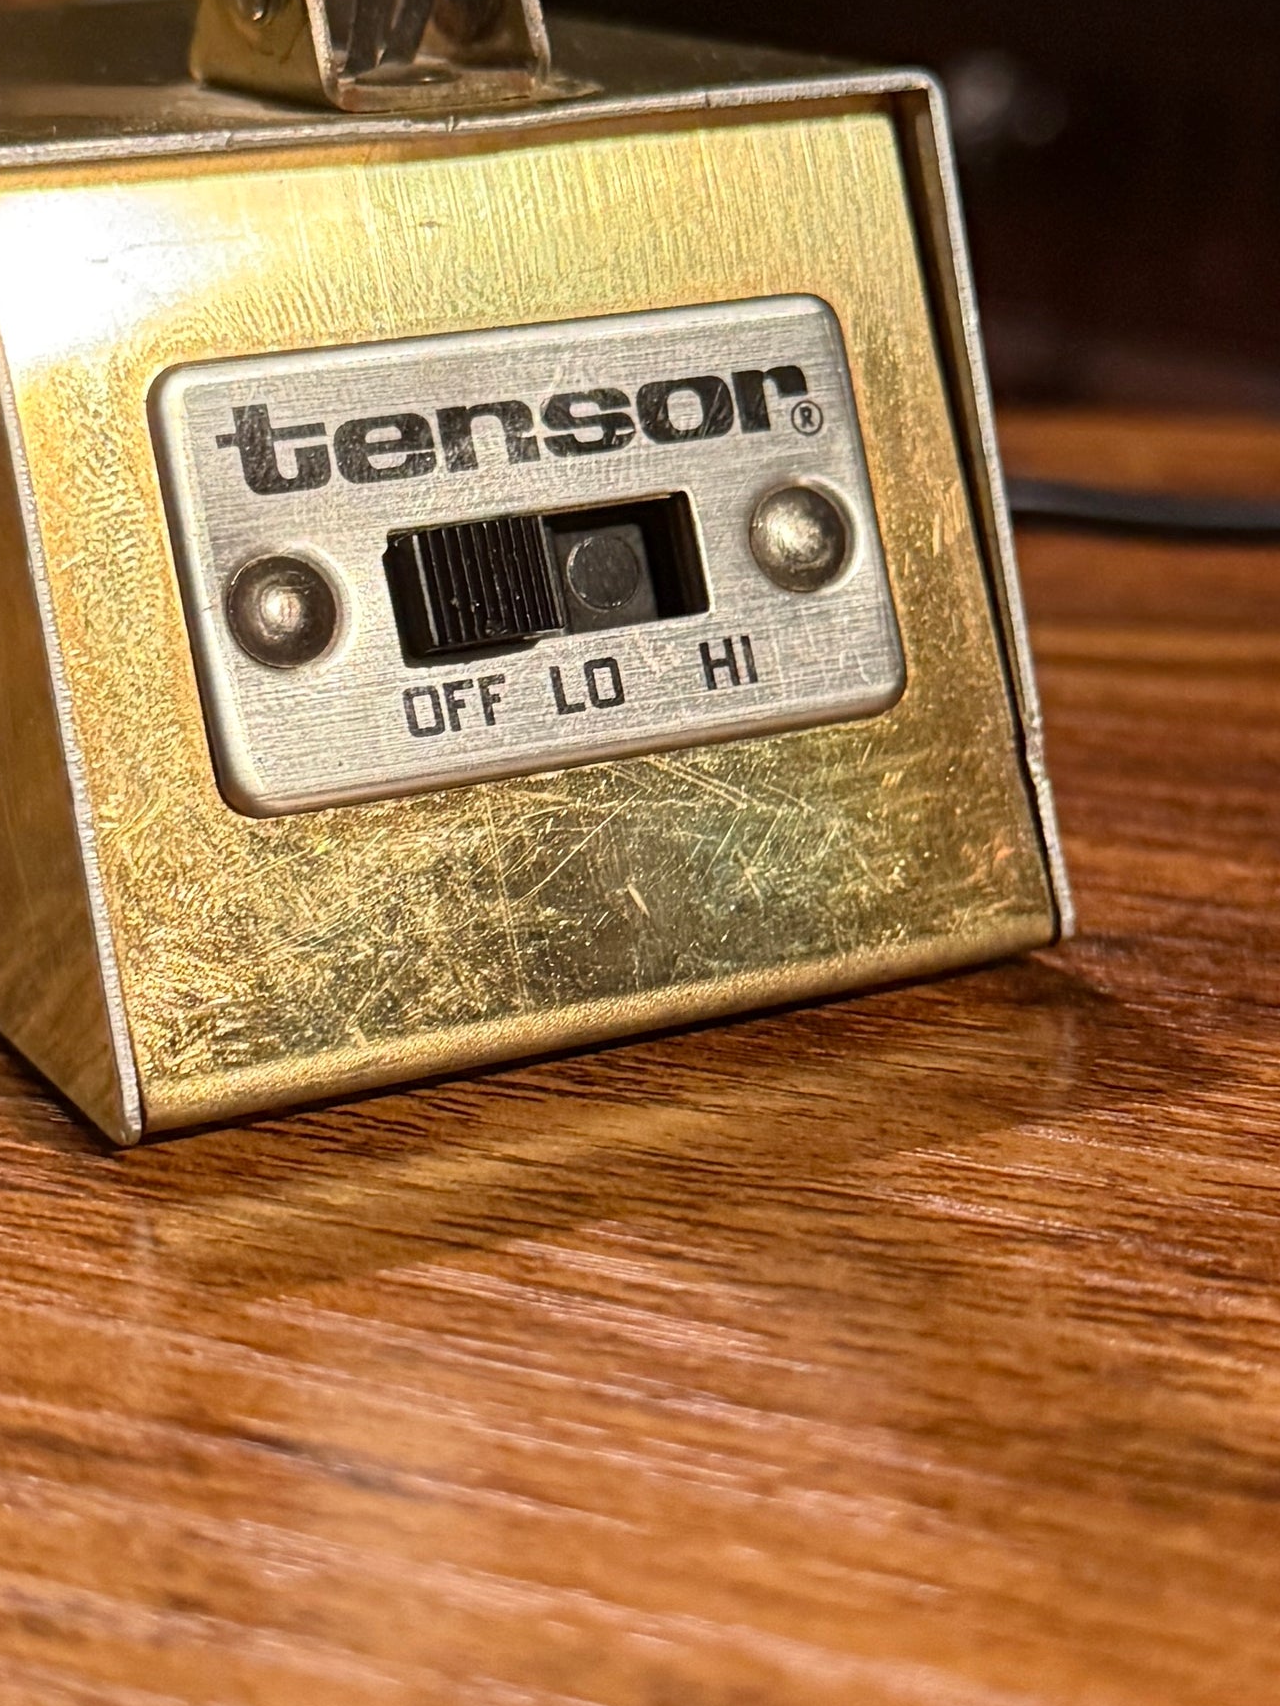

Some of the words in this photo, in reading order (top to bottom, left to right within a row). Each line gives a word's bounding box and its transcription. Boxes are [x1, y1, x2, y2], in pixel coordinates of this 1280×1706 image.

[402, 673, 506, 739] OFF
[549, 656, 626, 715] LO
[698, 635, 759, 690] HI
